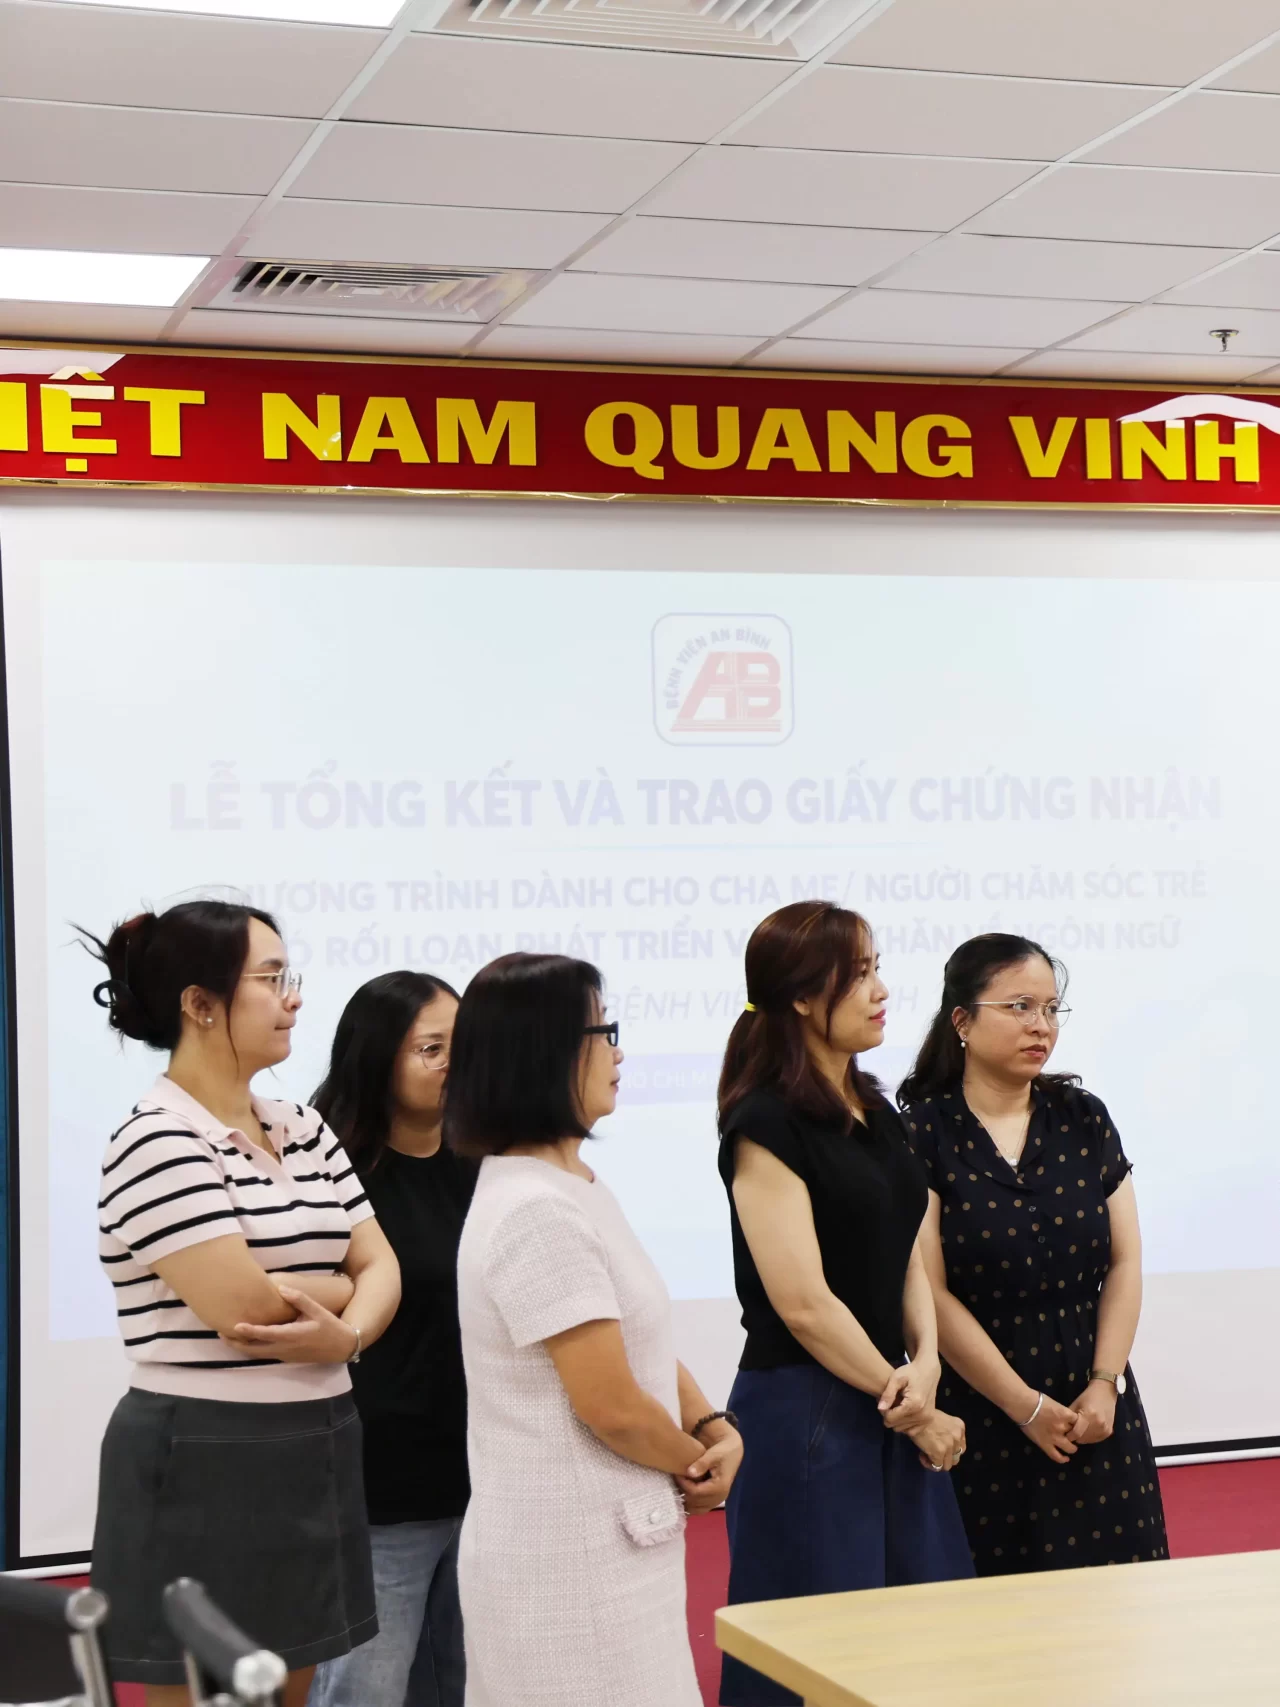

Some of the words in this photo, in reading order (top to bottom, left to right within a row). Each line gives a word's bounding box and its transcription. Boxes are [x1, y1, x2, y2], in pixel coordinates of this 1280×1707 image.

[0, 366, 205, 472] IỆT
[262, 392, 536, 466] NAM
[584, 401, 973, 480] QUANG
[1008, 415, 1260, 482] VINH
[710, 628, 731, 643] AN
[169, 759, 243, 831] LỄ
[260, 759, 426, 830] TỔNG
[444, 759, 542, 828] KẾT
[551, 766, 625, 827] VÀ
[637, 777, 773, 826] TRAO
[786, 759, 897, 825] GIẤY
[909, 764, 1076, 823] CHỨNG
[1089, 765, 1221, 832] NHẬN
[385, 869, 499, 912] TRÌNH
[511, 869, 613, 909] DÀNH
[622, 875, 700, 906] CHO
[709, 874, 781, 905] CHA
[865, 865, 971, 903] NGƯỜI
[980, 863, 1074, 902] CHĂM
[1083, 862, 1144, 899] SÓC
[325, 922, 391, 968] RỐI
[403, 933, 501, 974] LOẠN
[616, 914, 714, 960] TRIỂN
